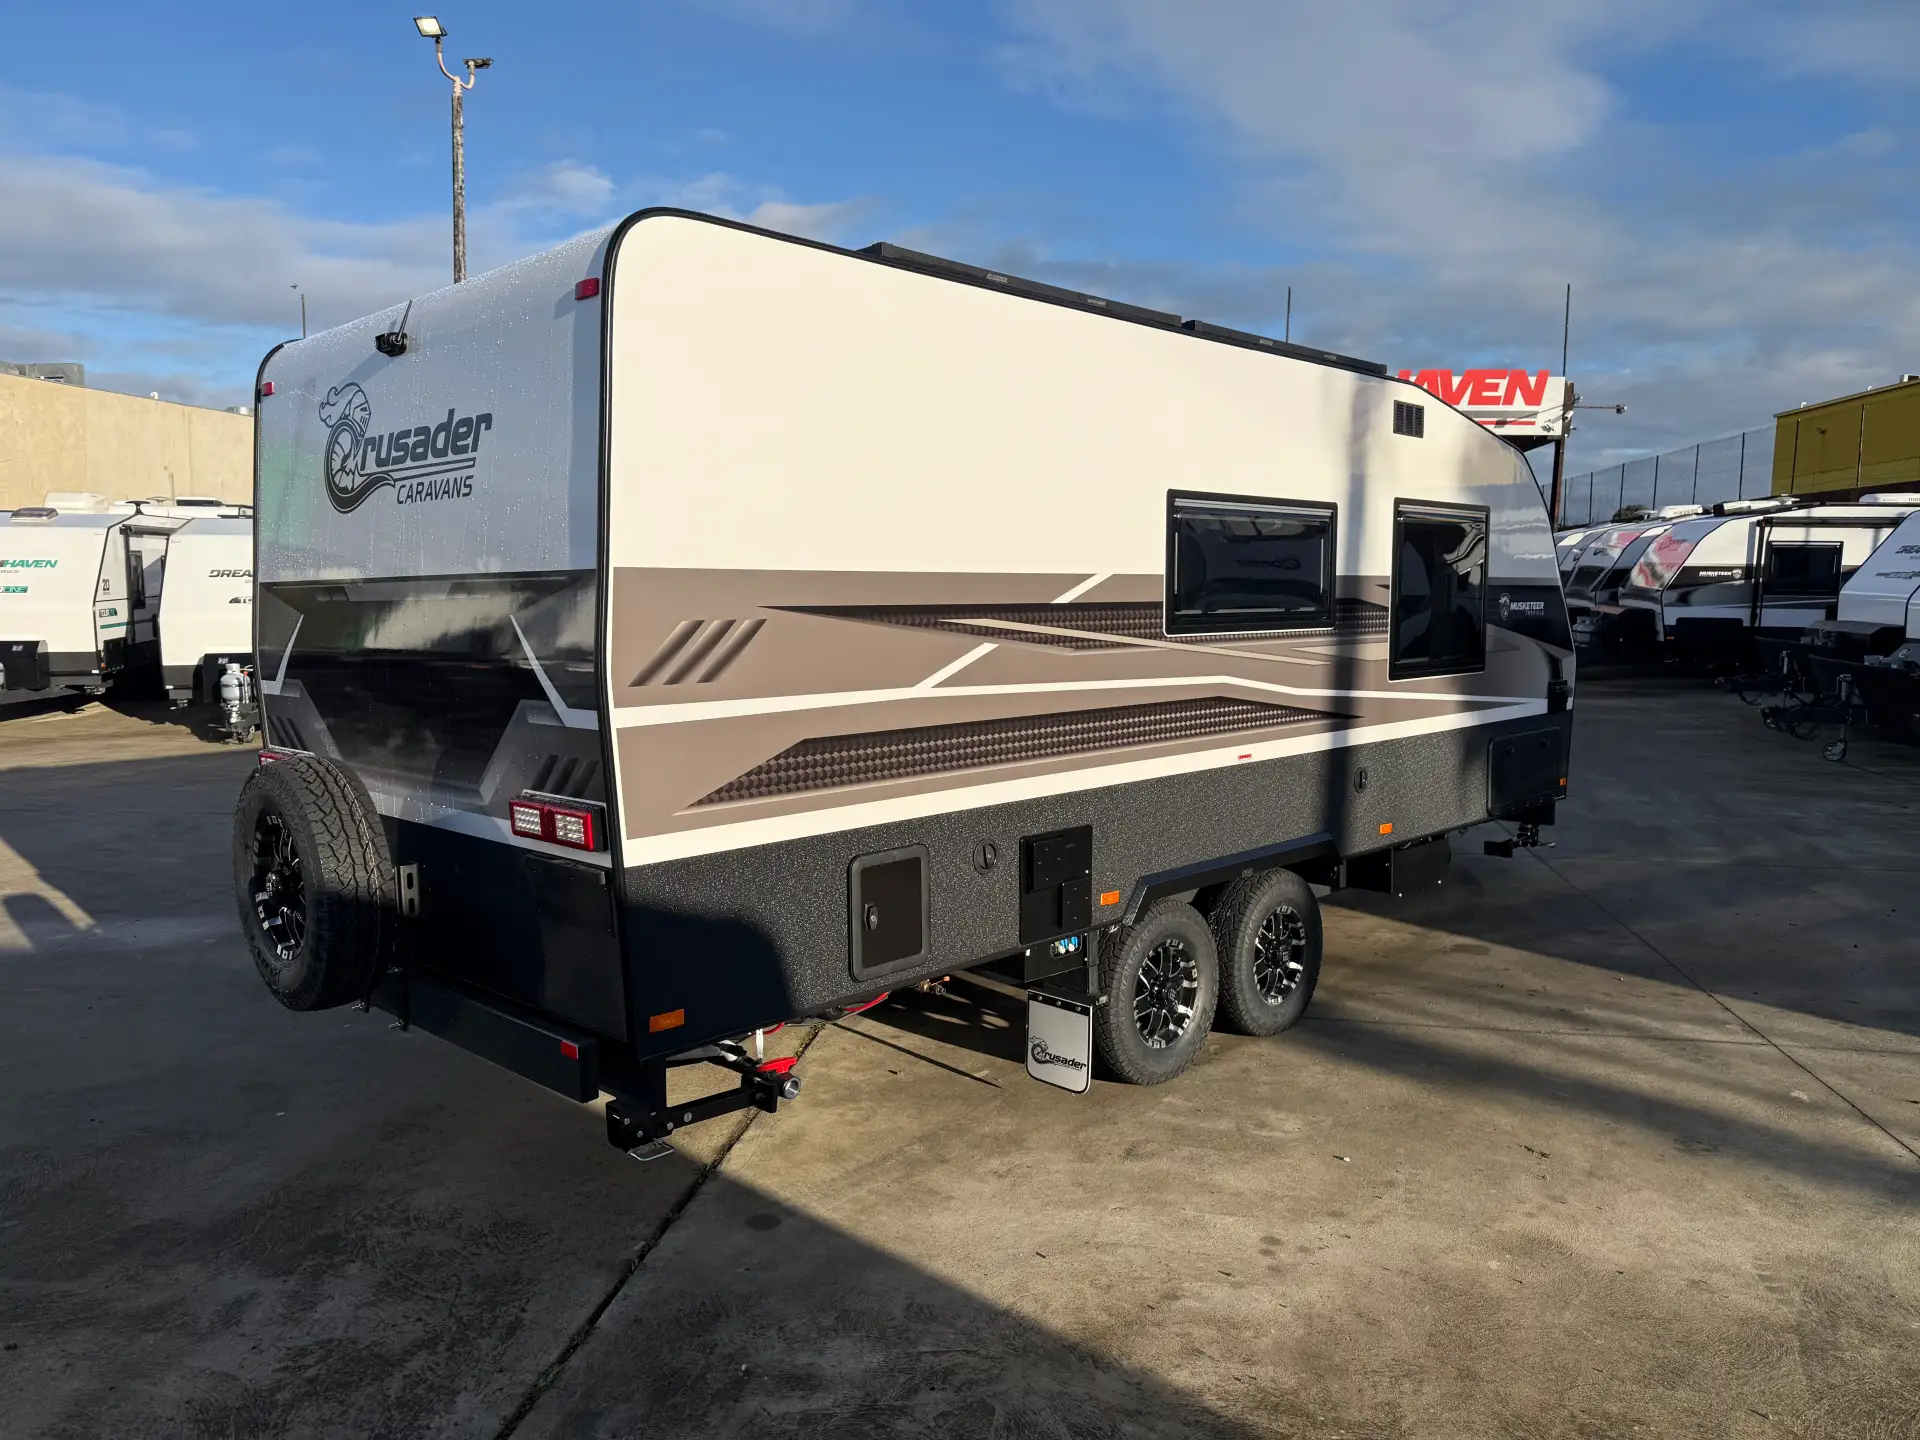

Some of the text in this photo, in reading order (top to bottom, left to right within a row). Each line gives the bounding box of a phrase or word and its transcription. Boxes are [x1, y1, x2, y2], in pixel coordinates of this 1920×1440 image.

[1397, 369, 1549, 407] AVEN
[396, 475, 474, 505] CARAVANS
[1510, 601, 1545, 611] MUSKETEER
[1030, 1043, 1087, 1071] Crusader
